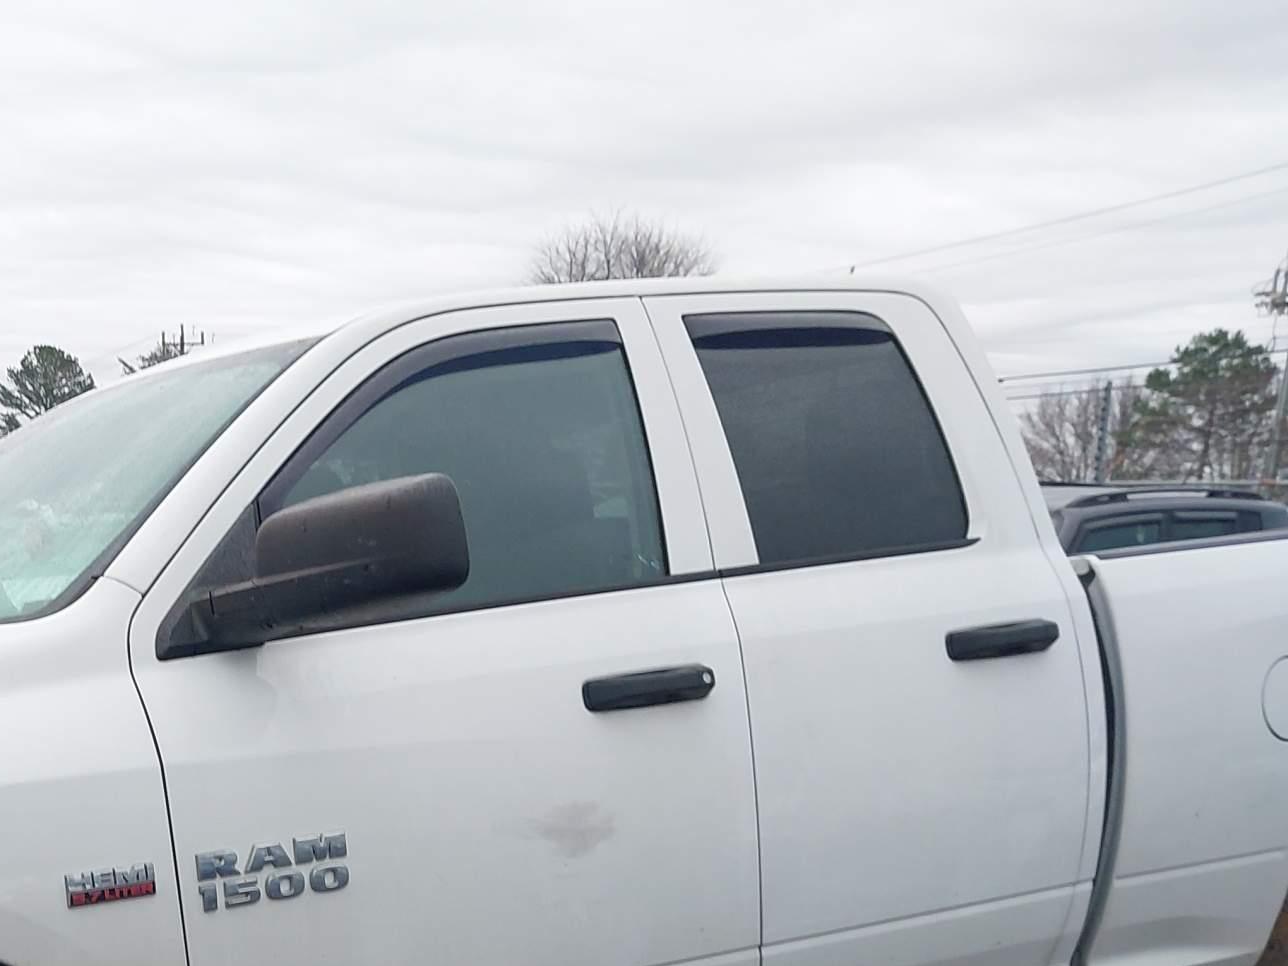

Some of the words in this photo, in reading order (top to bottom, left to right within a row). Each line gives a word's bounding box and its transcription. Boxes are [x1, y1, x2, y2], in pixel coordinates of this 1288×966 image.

[63, 861, 155, 891] HEMI
[194, 831, 348, 882] RAM
[198, 865, 350, 913] 1500
